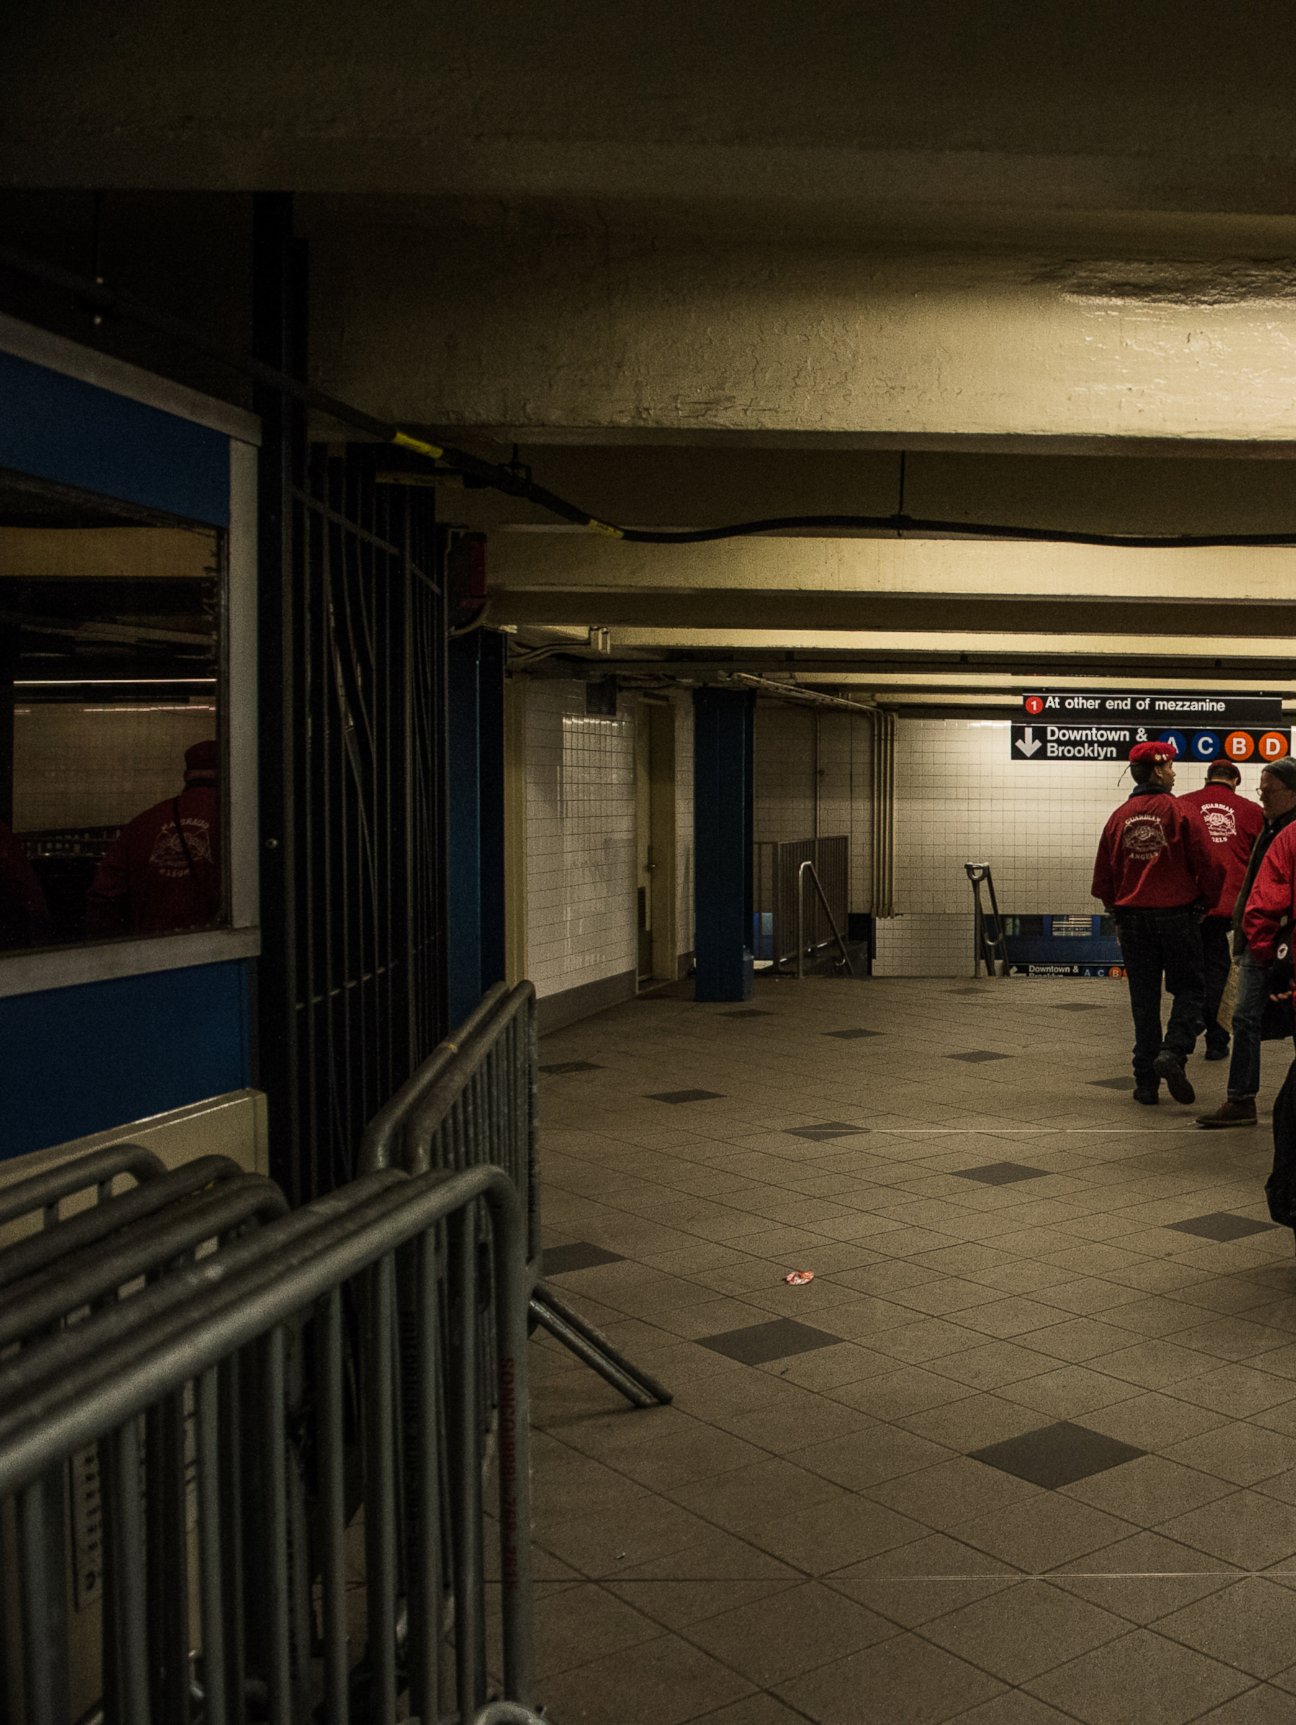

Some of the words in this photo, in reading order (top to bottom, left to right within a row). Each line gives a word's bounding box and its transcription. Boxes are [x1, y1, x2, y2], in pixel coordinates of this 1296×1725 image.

[1031, 700, 1037, 711] 1
[1045, 696, 1060, 709] At
[1065, 697, 1101, 710] other
[1106, 698, 1131, 710] end
[1136, 698, 1151, 710] of
[1155, 699, 1225, 712] mezzanine
[1047, 726, 1130, 741] Downtown
[1136, 728, 1148, 742] &
[1047, 742, 1117, 760] Brooklyn
[1167, 736, 1179, 754] A
[1197, 736, 1214, 755] C
[1232, 737, 1247, 755] B
[1265, 738, 1281, 755] D
[1029, 965, 1071, 973] Downtown
[1073, 965, 1079, 973] &
